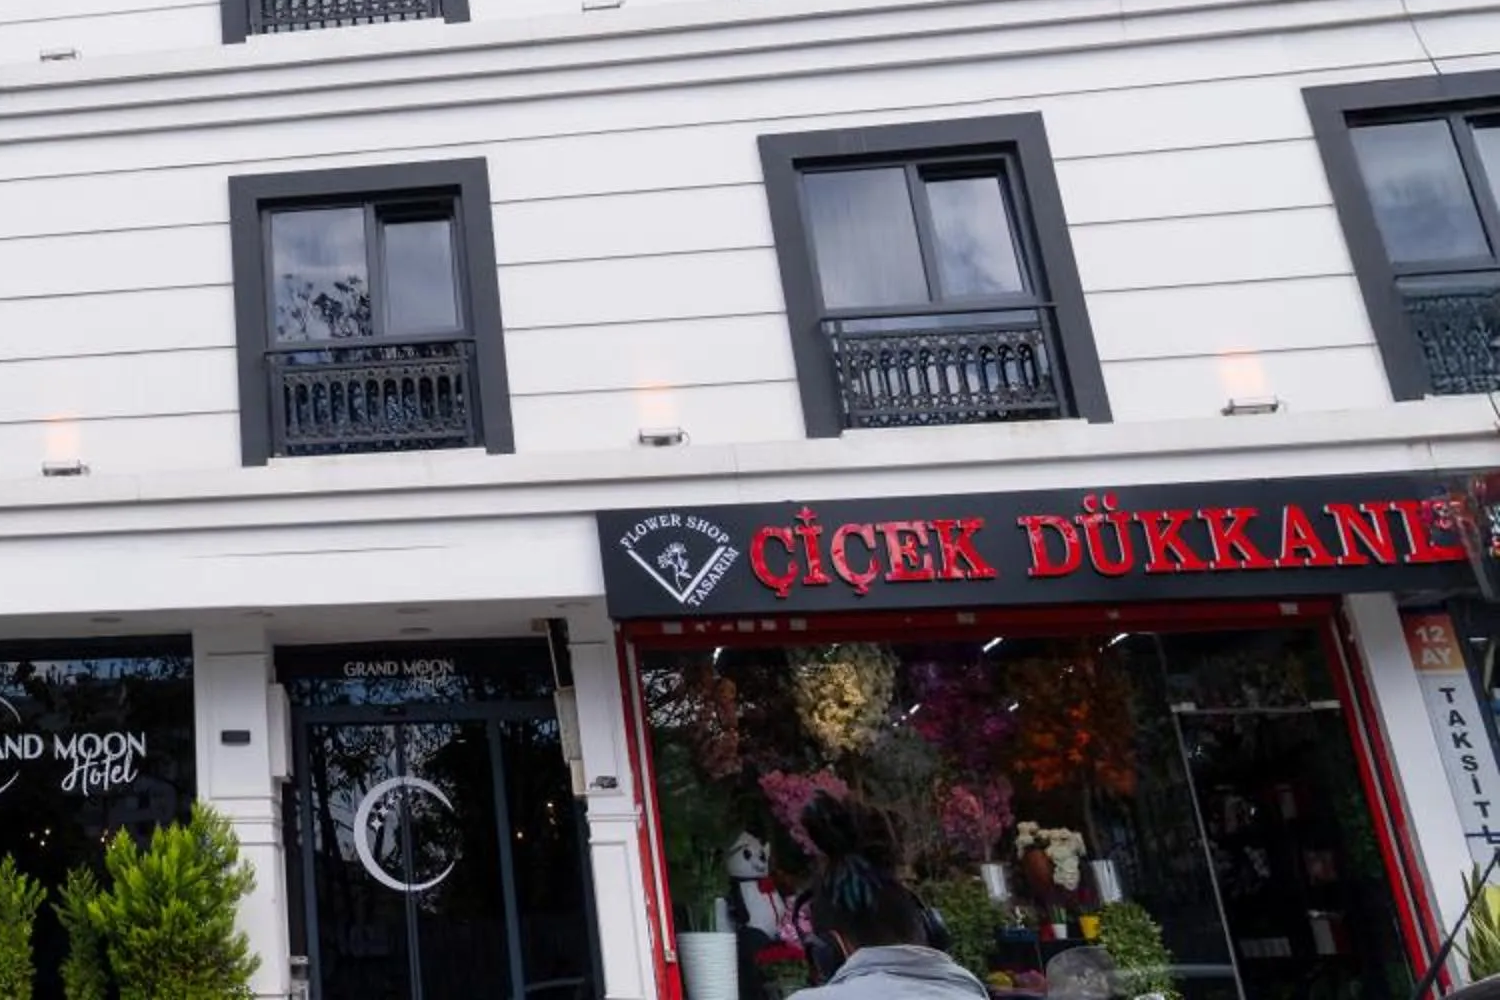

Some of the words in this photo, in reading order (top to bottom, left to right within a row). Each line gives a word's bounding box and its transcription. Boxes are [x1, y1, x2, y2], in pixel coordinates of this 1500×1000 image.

[686, 516, 730, 543] SHOP
[749, 505, 997, 597] ÇİÇEK
[687, 547, 739, 607] TASARIM
[1415, 625, 1445, 643] 12
[343, 661, 399, 676] GRAND
[402, 659, 455, 675] MOON
[1421, 648, 1452, 665] AY
[53, 731, 147, 760] MOON
[61, 749, 138, 797] Hotel
